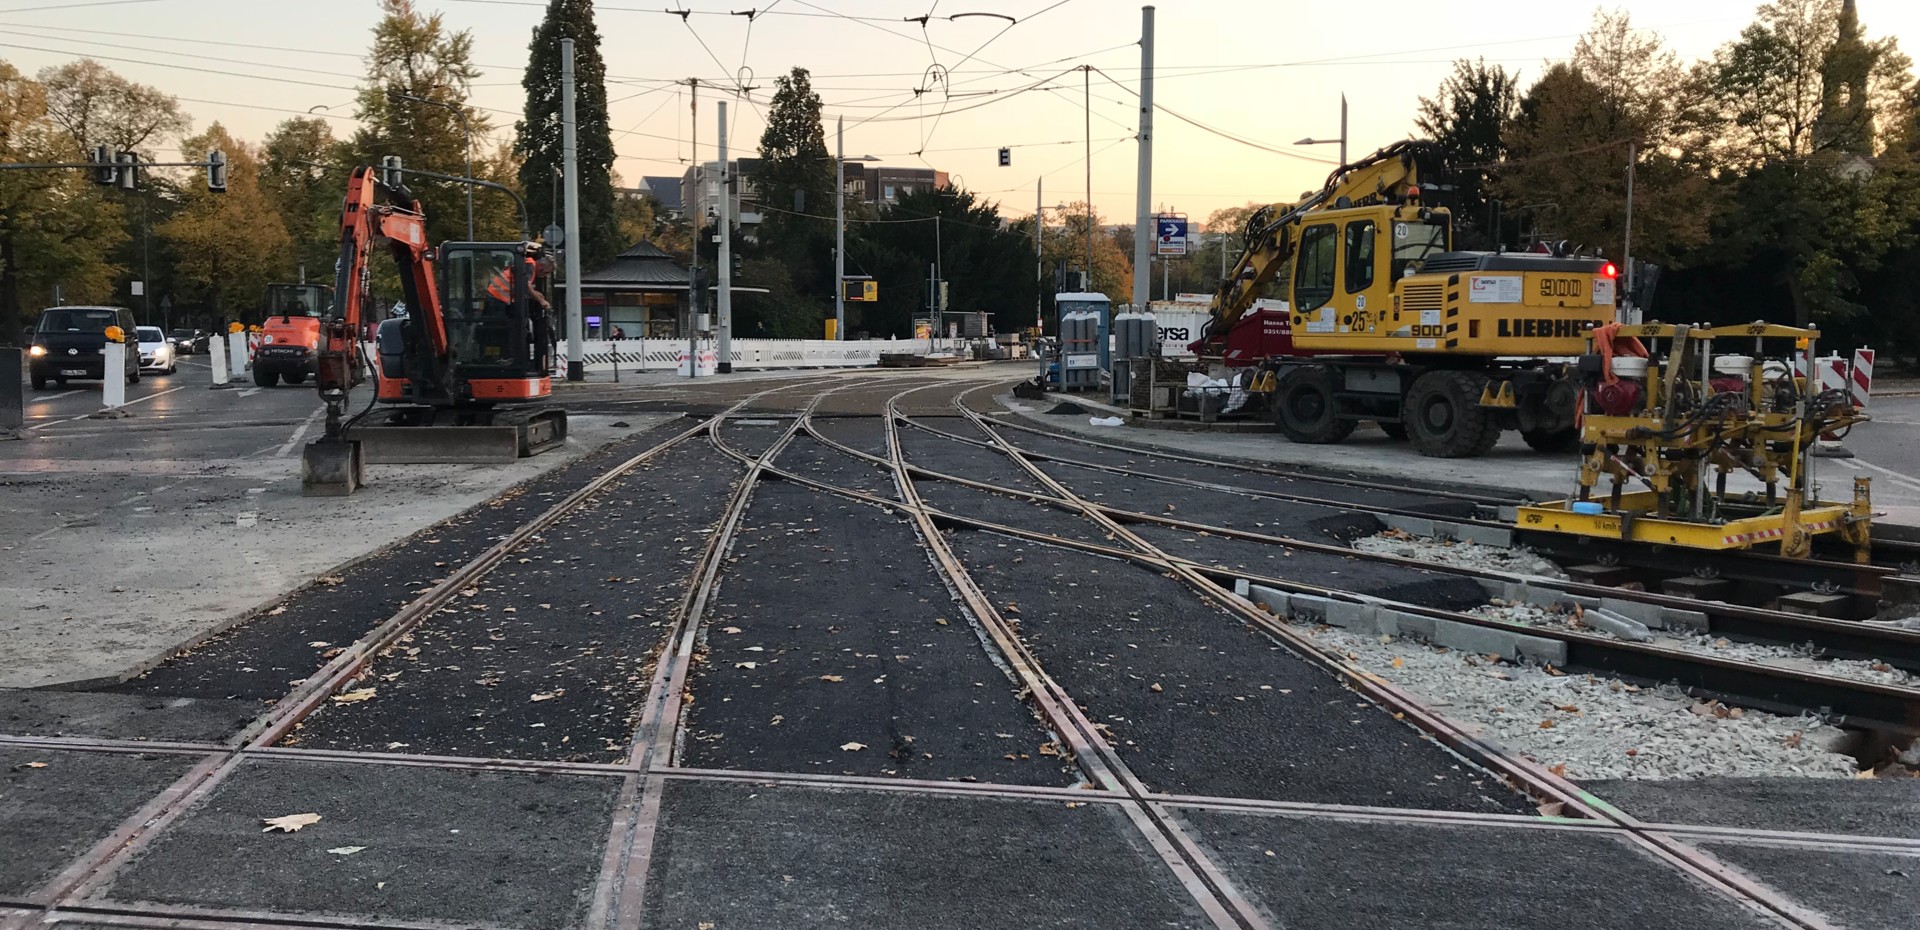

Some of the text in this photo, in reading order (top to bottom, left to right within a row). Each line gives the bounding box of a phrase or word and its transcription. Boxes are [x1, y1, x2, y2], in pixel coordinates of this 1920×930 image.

[1000, 149, 1009, 166] E
[1397, 225, 1407, 236] 20
[1541, 279, 1582, 297] 900
[1357, 296, 1365, 307] 20
[1351, 311, 1365, 331] 25
[1411, 324, 1443, 337] 900
